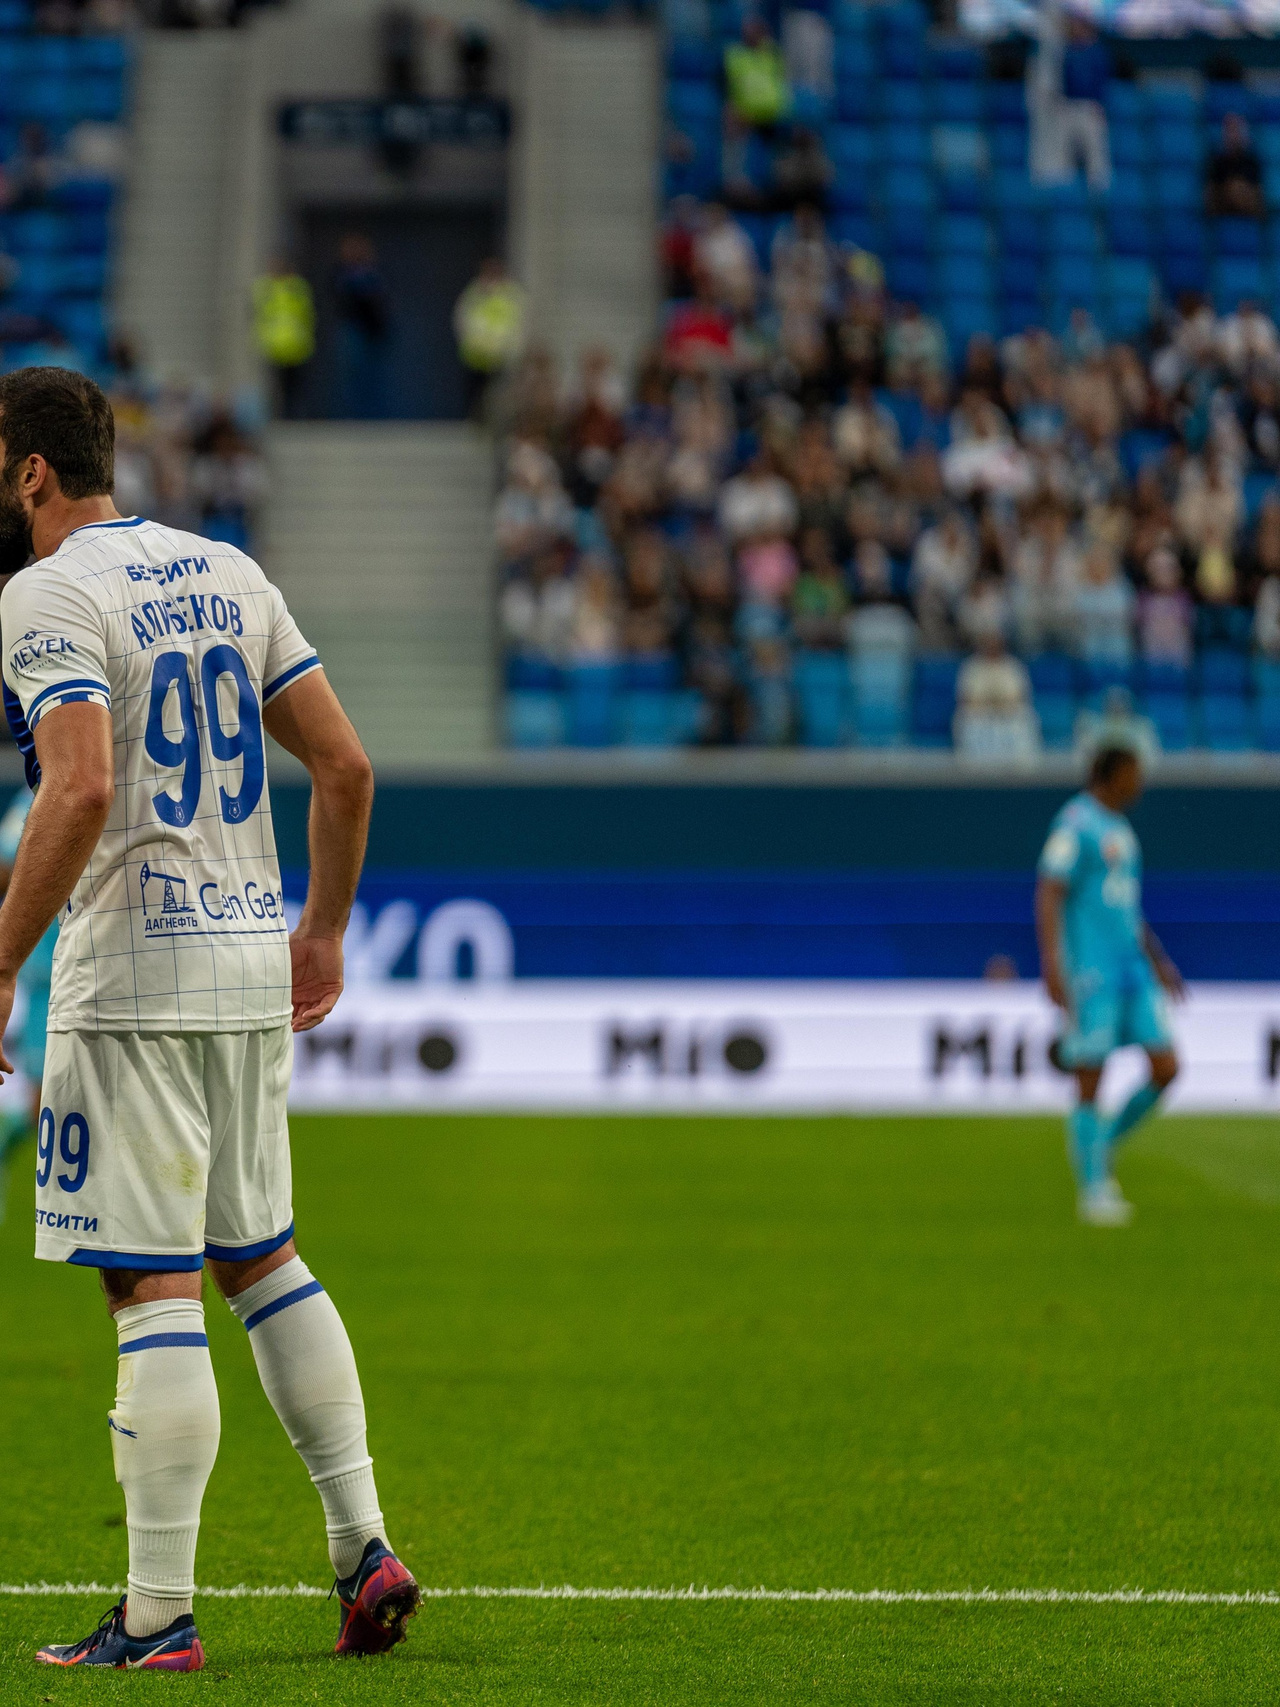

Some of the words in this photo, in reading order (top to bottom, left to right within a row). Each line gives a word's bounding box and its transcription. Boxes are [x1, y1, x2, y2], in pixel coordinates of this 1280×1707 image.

[125, 557, 210, 586] БЕСИТИ
[145, 644, 265, 828] 99
[145, 917, 198, 931] ДАГНЕФТЬ
[36, 1107, 90, 1193] 99
